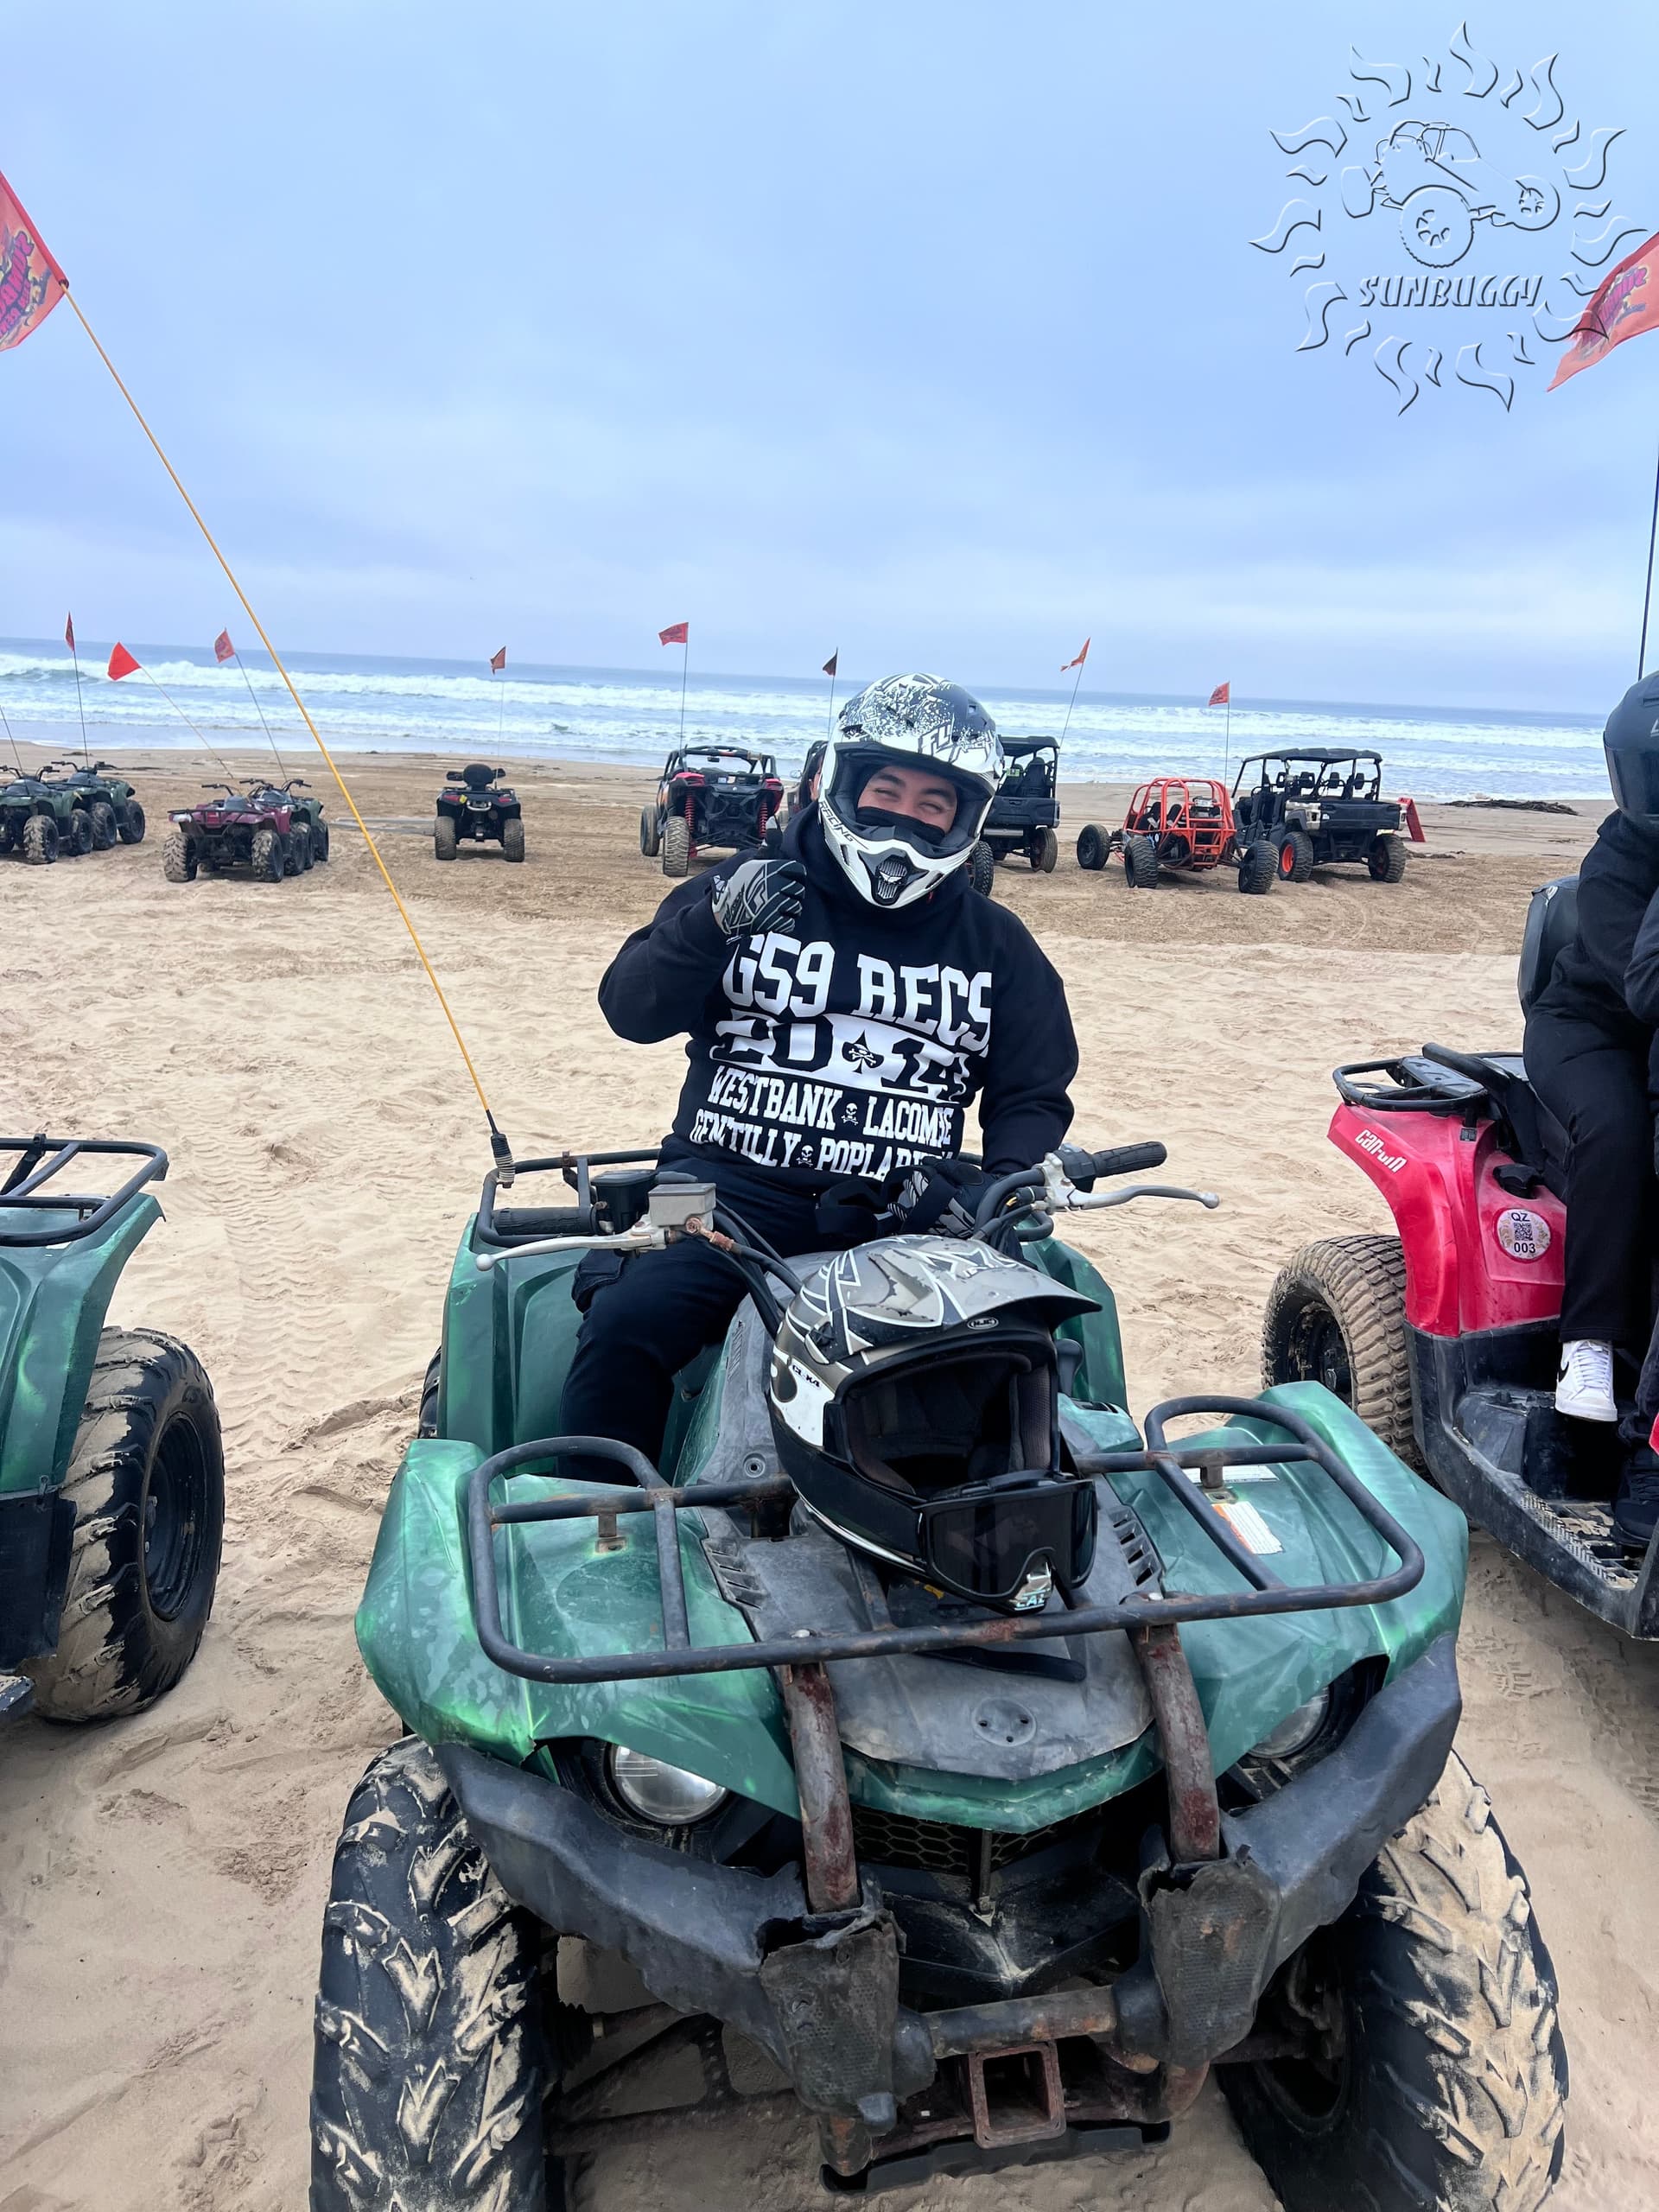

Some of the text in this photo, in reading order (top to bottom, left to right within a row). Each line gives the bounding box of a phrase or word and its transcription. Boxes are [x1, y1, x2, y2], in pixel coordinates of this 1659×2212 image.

[819, 801, 854, 842] RACING
[722, 931, 835, 1018] G59
[707, 1065, 955, 1148] WESTBANK LACOMBE
[690, 1108, 803, 1168] GENTILLY
[1510, 1212, 1531, 1223] QZ
[1514, 1242, 1536, 1254] 003
